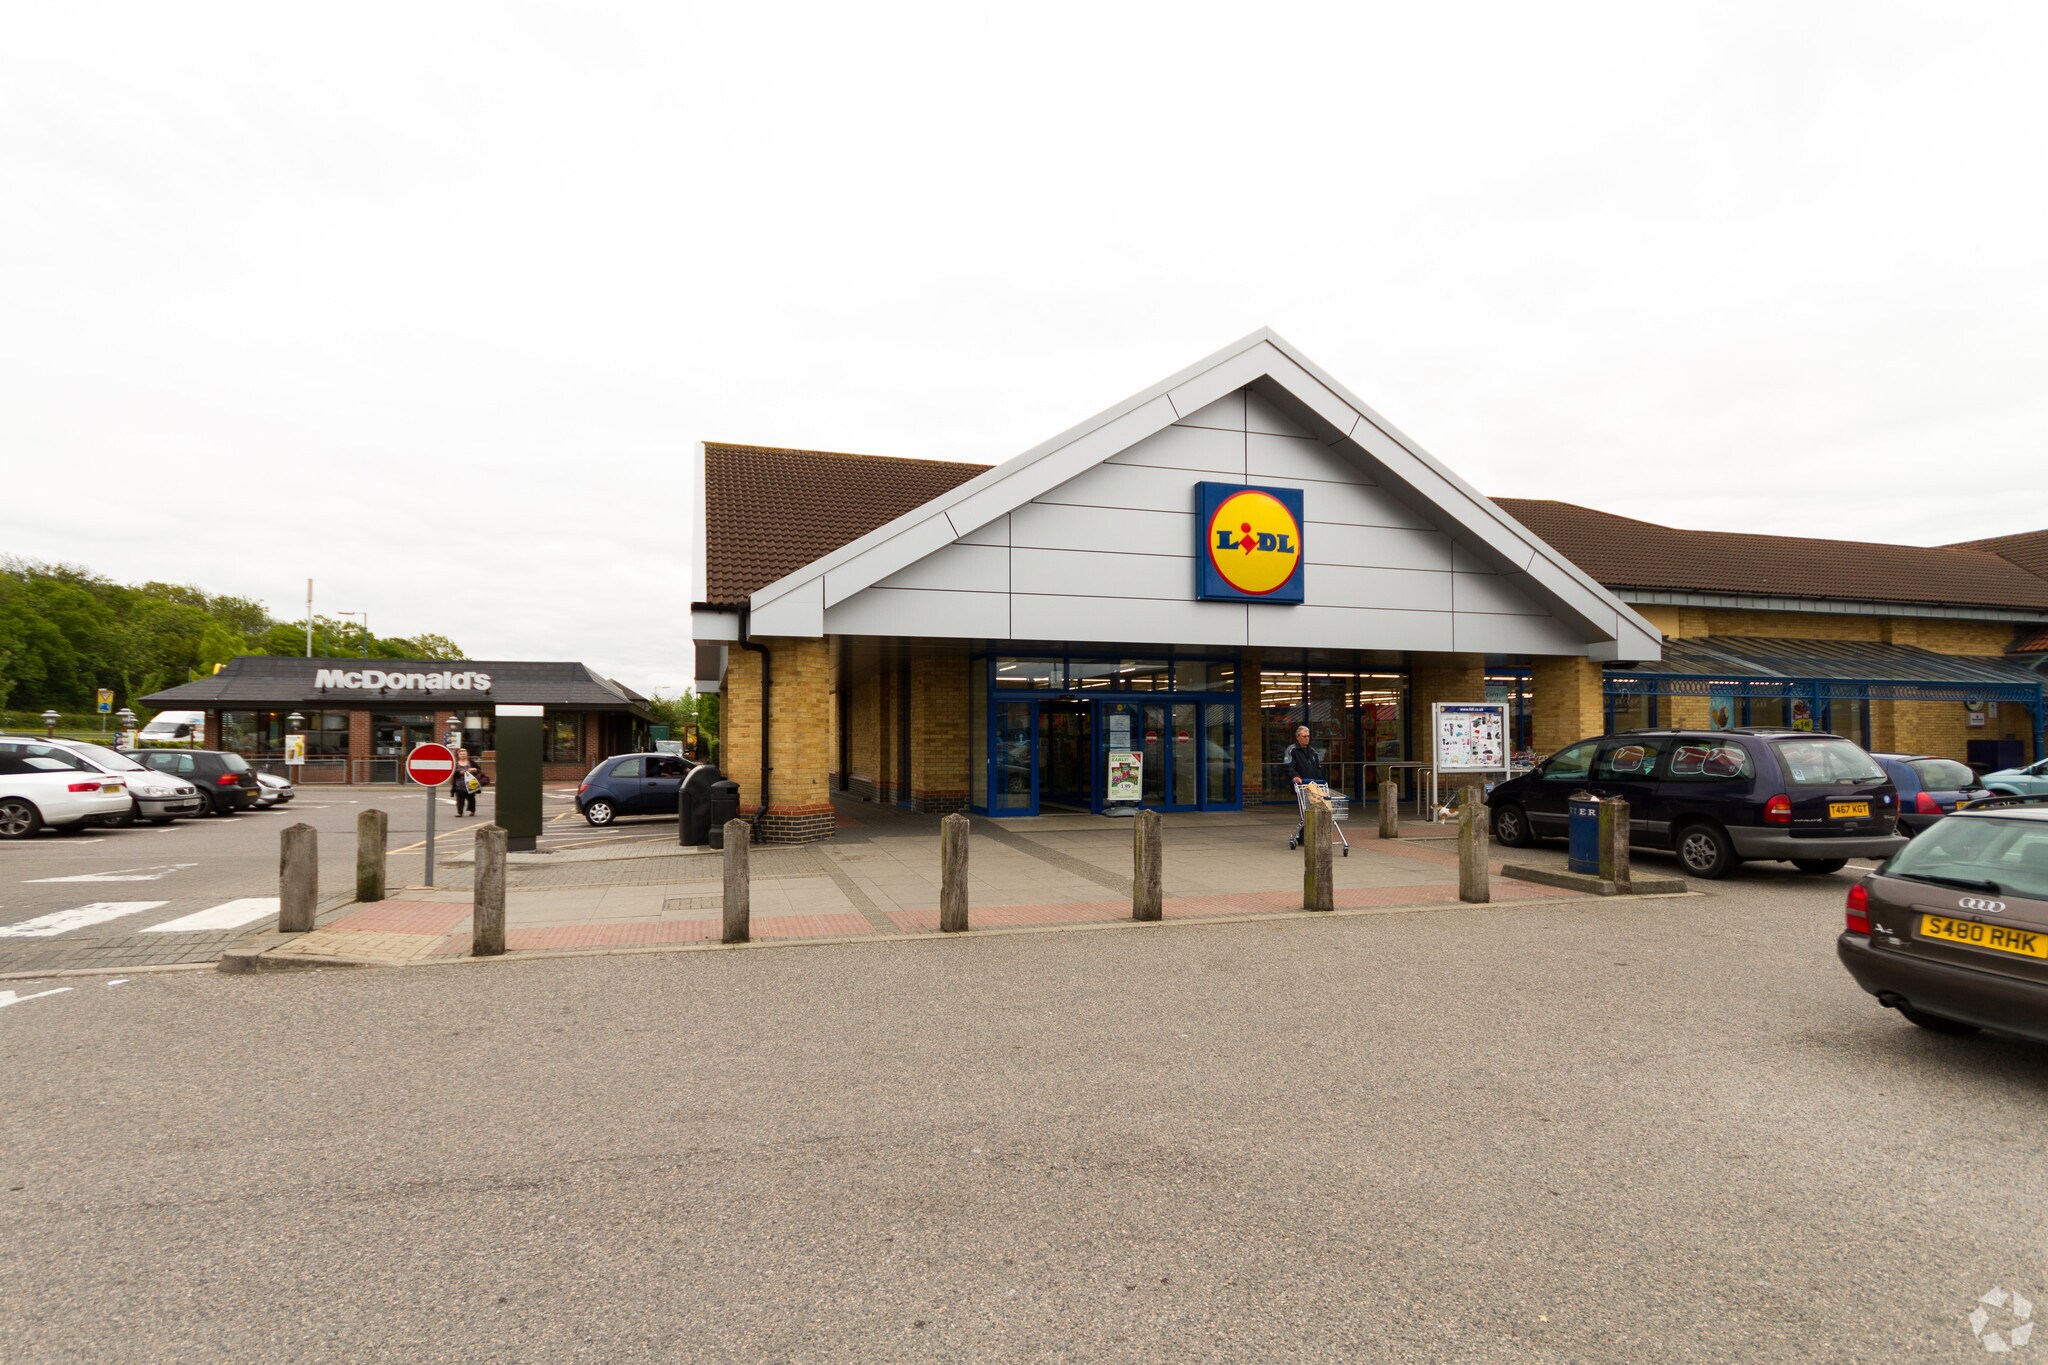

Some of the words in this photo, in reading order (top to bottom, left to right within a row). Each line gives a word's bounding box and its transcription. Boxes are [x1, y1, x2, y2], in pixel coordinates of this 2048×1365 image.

[314, 669, 492, 691] McDonald's
[1831, 805, 1850, 814] T467
[1853, 804, 1867, 813] KGT
[1929, 917, 1983, 942] S480
[1990, 928, 2038, 953] RHK
